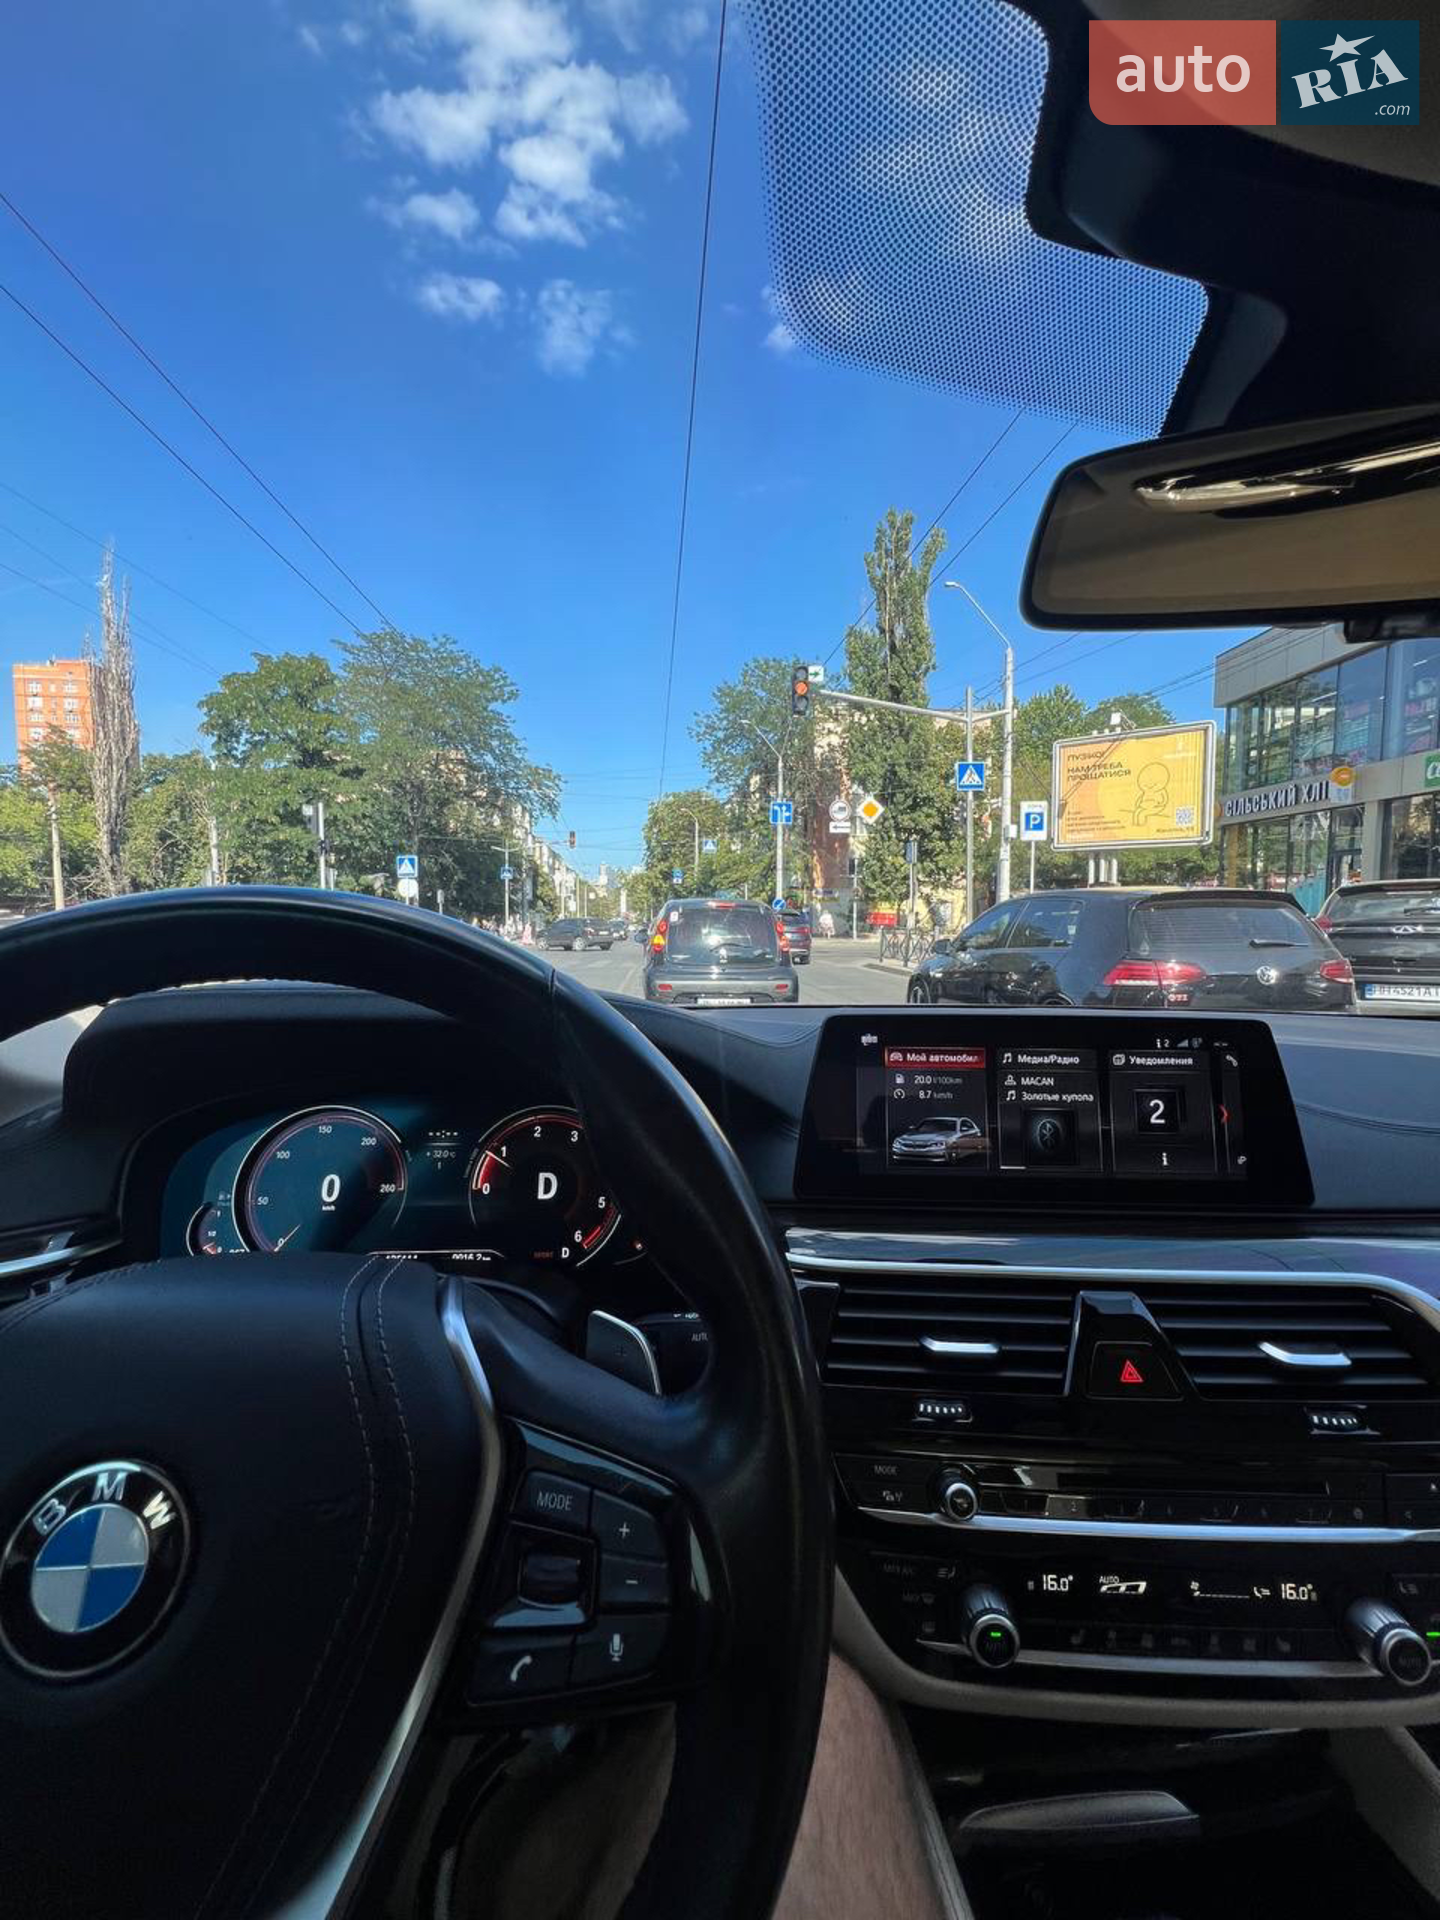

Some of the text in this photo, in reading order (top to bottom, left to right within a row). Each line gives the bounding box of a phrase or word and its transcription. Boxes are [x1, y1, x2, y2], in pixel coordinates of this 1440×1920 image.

[1225, 780, 1330, 817] СІЛЬСЬКИЙ ХЛІ
[1030, 813, 1041, 828] P
[906, 1053, 927, 1062] Мой
[1018, 1054, 1080, 1065] Медиа/Радио
[1129, 1056, 1193, 1066] Уведомления
[914, 1075, 932, 1084] 20.0
[1021, 1077, 1054, 1086] MACAN
[919, 1090, 932, 1099] 8.7
[1022, 1092, 1060, 1102] Золотые
[1149, 1099, 1166, 1124] 2
[318, 1126, 332, 1134] 150
[533, 1126, 541, 1137] 2
[361, 1137, 376, 1146] 200
[570, 1131, 578, 1142] 3
[276, 1151, 290, 1160] 100
[500, 1147, 507, 1157] 1
[321, 1174, 341, 1202] 0
[380, 1184, 395, 1193] 260
[482, 1183, 490, 1194] 0
[537, 1172, 558, 1200] D
[257, 1196, 268, 1206] 50
[598, 1197, 606, 1208] 5
[574, 1231, 582, 1242] 6
[561, 1248, 569, 1258] D
[33, 1472, 177, 1535] BMW
[536, 1491, 573, 1511] MODE
[1099, 1575, 1120, 1584] AUTO
